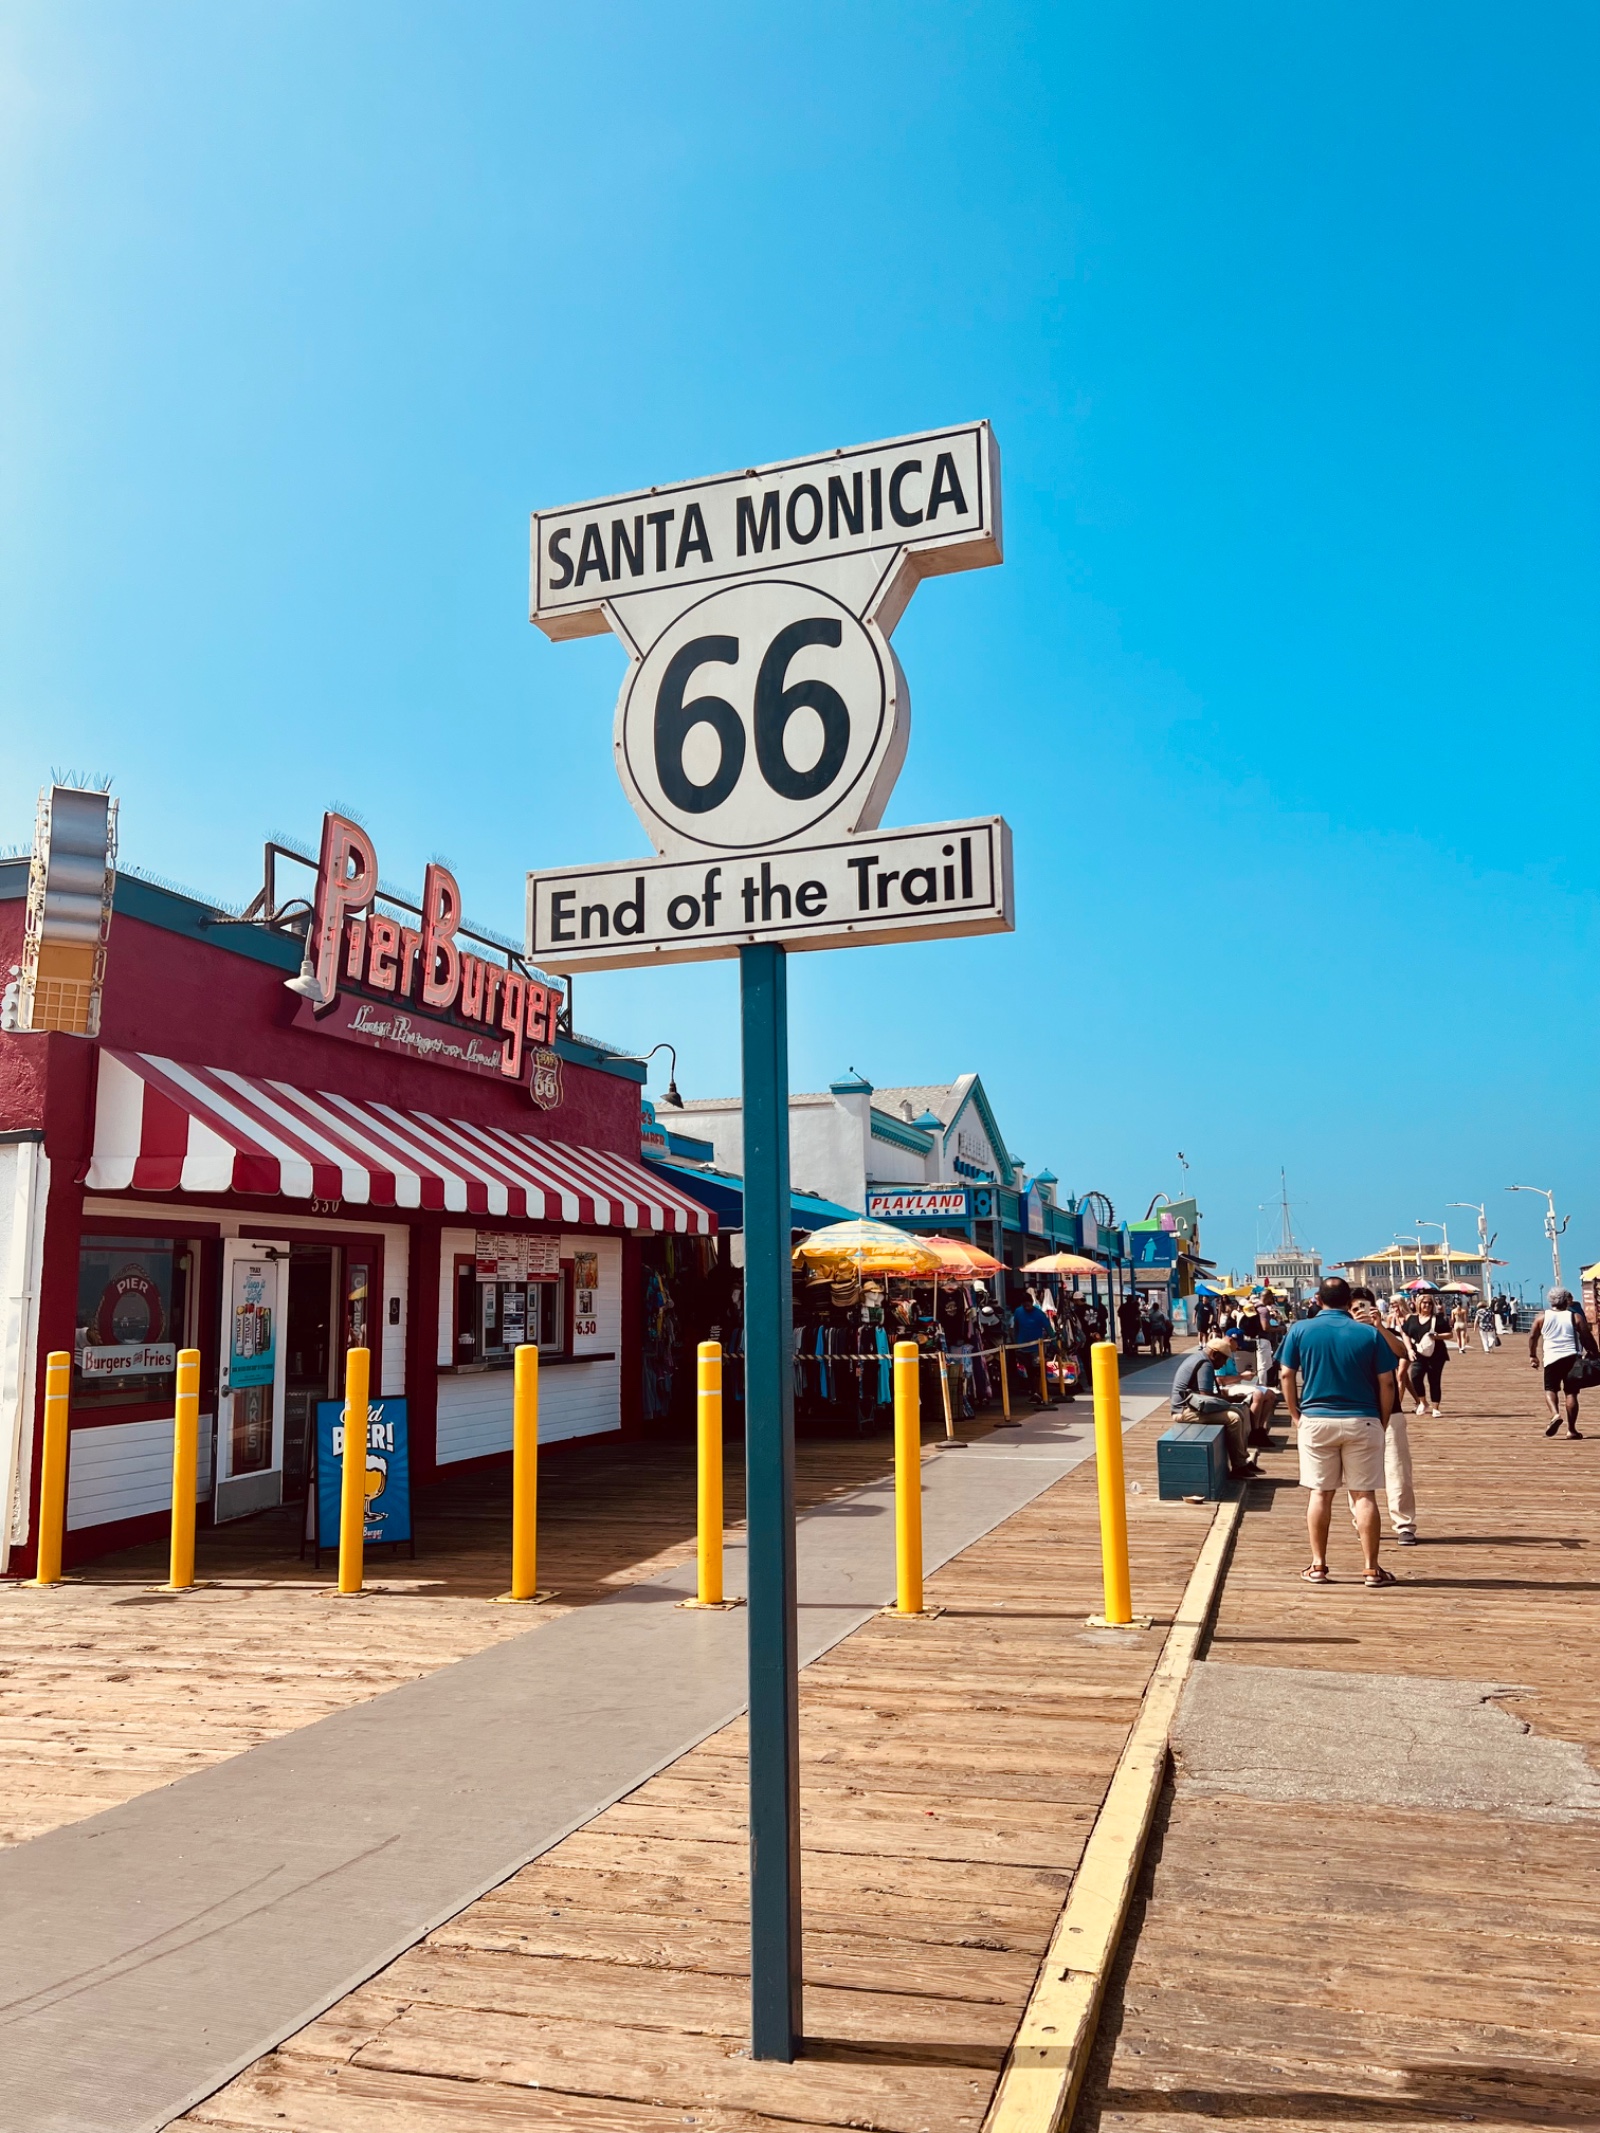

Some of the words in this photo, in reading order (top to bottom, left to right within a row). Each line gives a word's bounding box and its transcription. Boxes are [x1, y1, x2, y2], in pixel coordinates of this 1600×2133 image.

[548, 503, 713, 590] SANTA
[736, 452, 969, 557] MONICA
[653, 617, 850, 814] 66
[551, 877, 645, 942] End
[667, 868, 721, 930] of
[741, 862, 828, 923] the
[848, 838, 973, 911] Trail
[534, 1070, 558, 1098] 66
[871, 1194, 964, 1210] PLAYLAND
[884, 1208, 950, 1216] ARCADE
[116, 1277, 149, 1294] PIER
[352, 1277, 362, 1337] CNES
[85, 1352, 131, 1373] Burgers
[144, 1348, 172, 1367] Fries
[248, 1386, 258, 1449] HAKES
[332, 1423, 394, 1456] BER!
